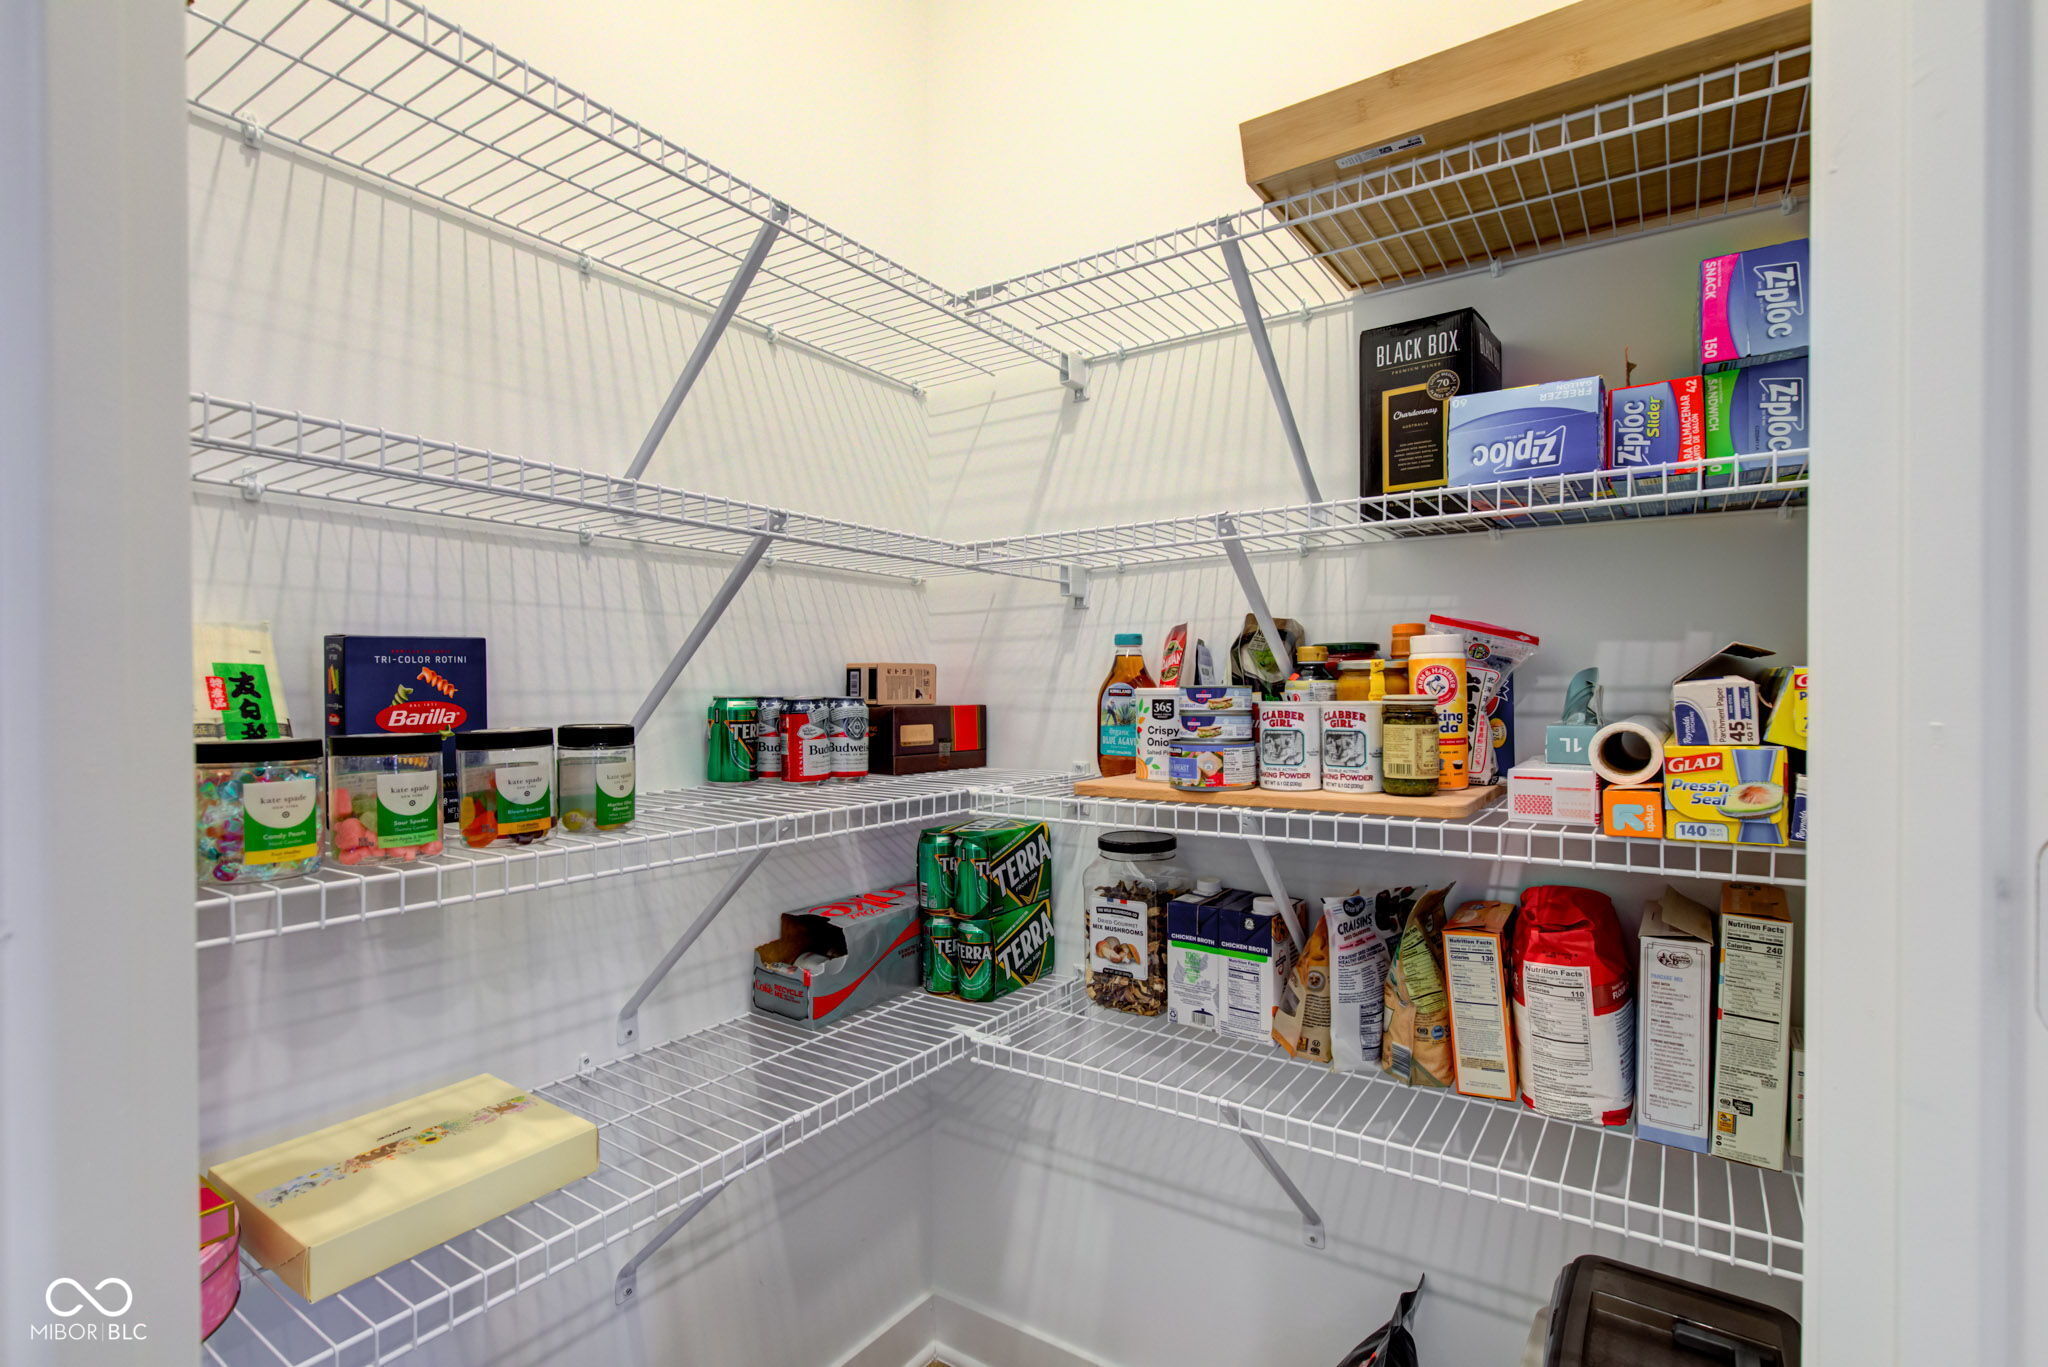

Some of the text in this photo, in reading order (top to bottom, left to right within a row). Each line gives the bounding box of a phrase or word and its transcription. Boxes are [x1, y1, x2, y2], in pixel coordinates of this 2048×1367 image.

[1705, 261, 1717, 300] SNACK
[1756, 266, 1797, 338] Ziploc
[1376, 336, 1422, 368] BLACK
[1428, 329, 1459, 356] BOX
[1704, 337, 1718, 359] 150
[1436, 378, 1450, 388] 70
[1556, 379, 1593, 391] GALLON
[1685, 379, 1698, 393] 42
[1539, 385, 1593, 402] FREEZER
[1452, 397, 1467, 408] 60
[1707, 379, 1720, 432] SANDWICH
[1393, 407, 1438, 421] Chardonnay
[1646, 394, 1661, 438] Slider
[1759, 381, 1800, 451] Ziploc
[1402, 421, 1429, 430] AUSTRALIA
[1617, 400, 1652, 464] Ziploc
[1680, 394, 1694, 462] ARA ALMACENAR
[1472, 430, 1558, 468] Ziploc
[374, 656, 467, 664] TRI-COLOR ROTINI
[1431, 667, 1456, 689] HAMMER
[1154, 703, 1172, 713] 365
[1717, 687, 1727, 743] Parchment Paper
[388, 708, 456, 727] Barilla
[1262, 710, 1305, 721] CLABBER
[1324, 710, 1367, 722] CLABBER
[1269, 719, 1293, 728] GIRL
[1330, 719, 1354, 728] GIRL
[1440, 722, 1459, 733] da
[1683, 716, 1692, 744] Reynolds
[1147, 726, 1180, 736] Crispy
[1728, 721, 1747, 743] 45
[1747, 722, 1754, 742] SQ FT
[1147, 737, 1170, 747] Onio
[1560, 738, 1582, 752] 1L
[1668, 755, 1721, 773] GLAD
[525, 776, 542, 784] spade
[1260, 771, 1278, 779] AKING
[1339, 773, 1374, 781] POWDER
[411, 784, 430, 793] spade
[1671, 778, 1730, 793] Press'n
[284, 794, 306, 803] spade
[1690, 792, 1728, 806] Seal
[1679, 824, 1708, 838] 140
[991, 833, 1052, 898] TERRA
[1097, 917, 1138, 929] DRIED GOURMET
[1337, 914, 1373, 935] CRAISINS
[1728, 920, 1784, 934] Nutrition Facts
[1104, 926, 1144, 936] MUSHROOMS
[998, 911, 1055, 980] TERRA
[1171, 933, 1215, 945] CHICKEN BROTH
[1221, 941, 1268, 954] CHICKEN BROTH
[1726, 942, 1783, 955] Calories 240
[1525, 965, 1559, 976] Nutrition
[755, 979, 773, 994] Coke
[774, 983, 804, 998] RECYCLE
[1528, 985, 1550, 994] Calories
